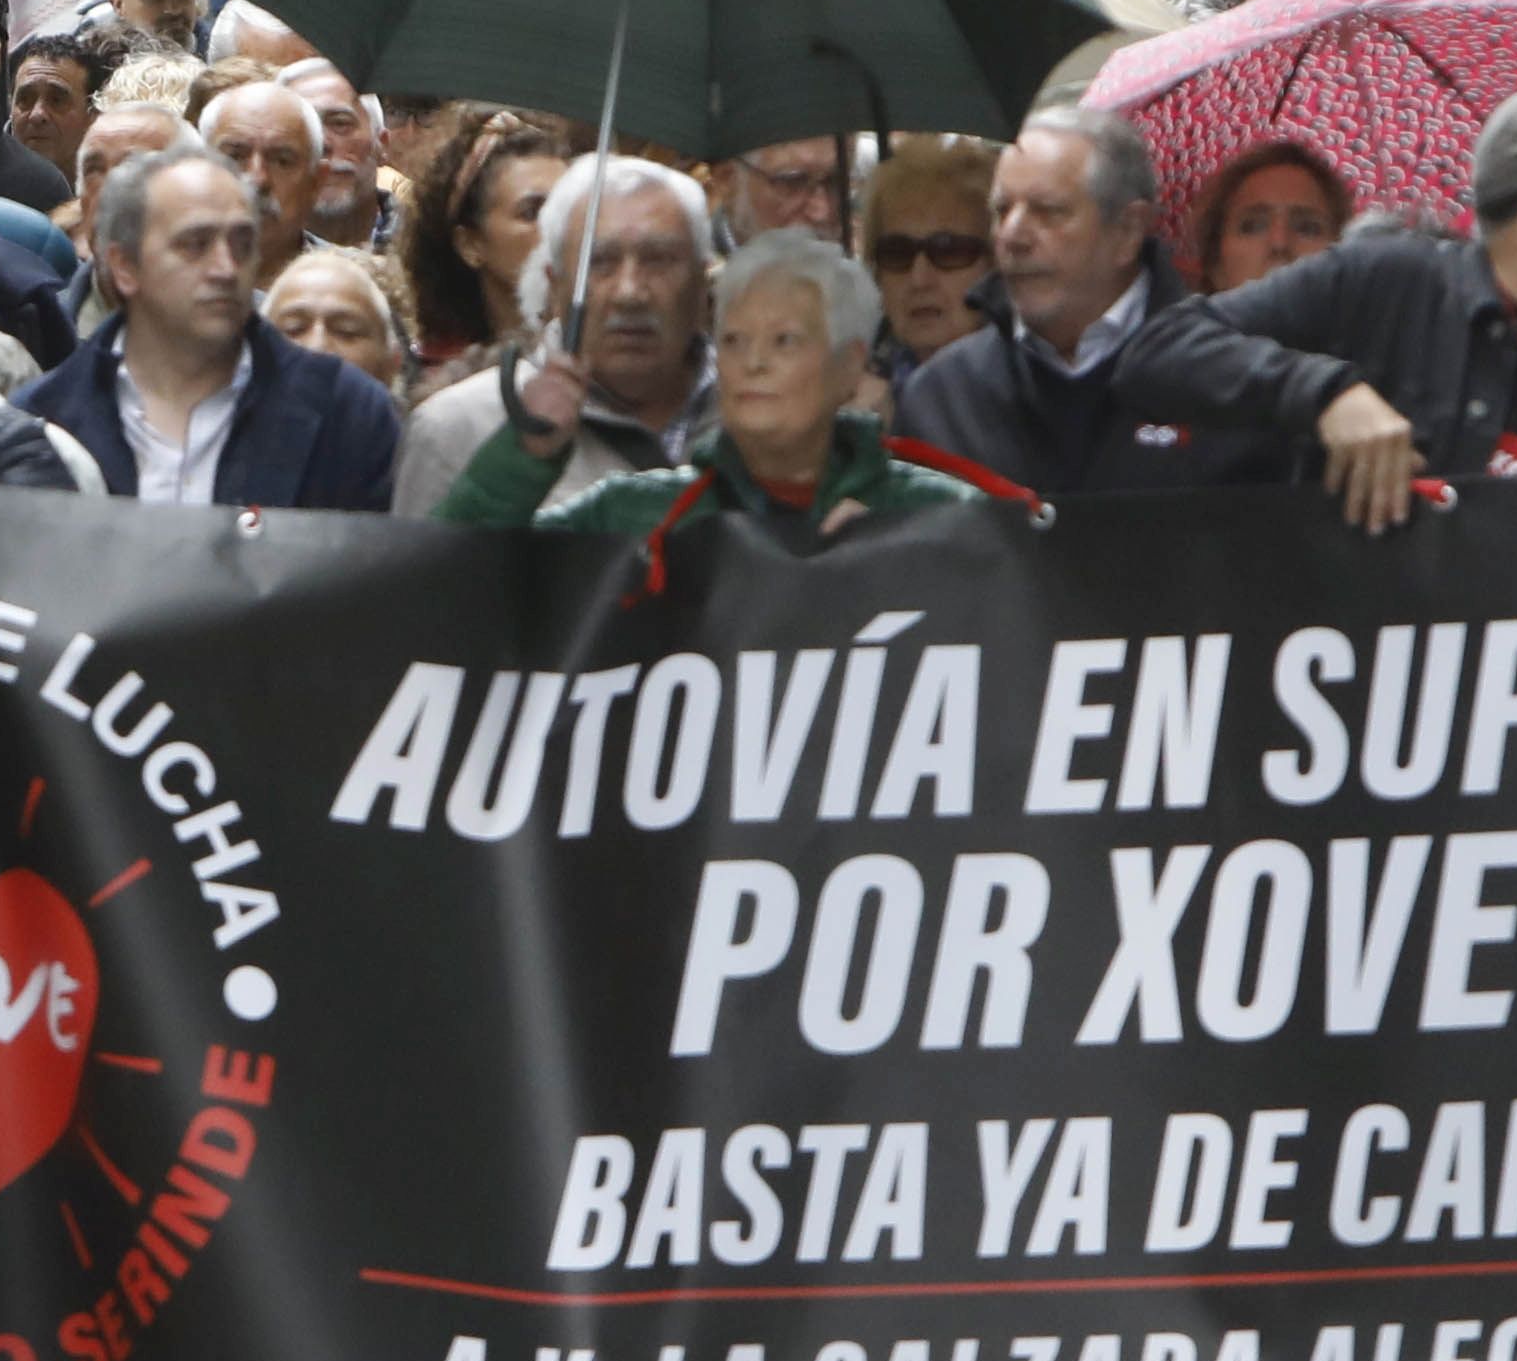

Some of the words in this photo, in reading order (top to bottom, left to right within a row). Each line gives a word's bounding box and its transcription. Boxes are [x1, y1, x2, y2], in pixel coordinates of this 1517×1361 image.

[39, 632, 281, 950] LUCHA
[329, 610, 982, 842] AUTOVÍA
[1024, 632, 1231, 814] EN
[670, 852, 1051, 1057] POR
[117, 1045, 276, 1326] RINDE
[546, 1122, 930, 1271] BASTA
[975, 1116, 1113, 1258] YA
[1144, 1108, 1309, 1253] DE
